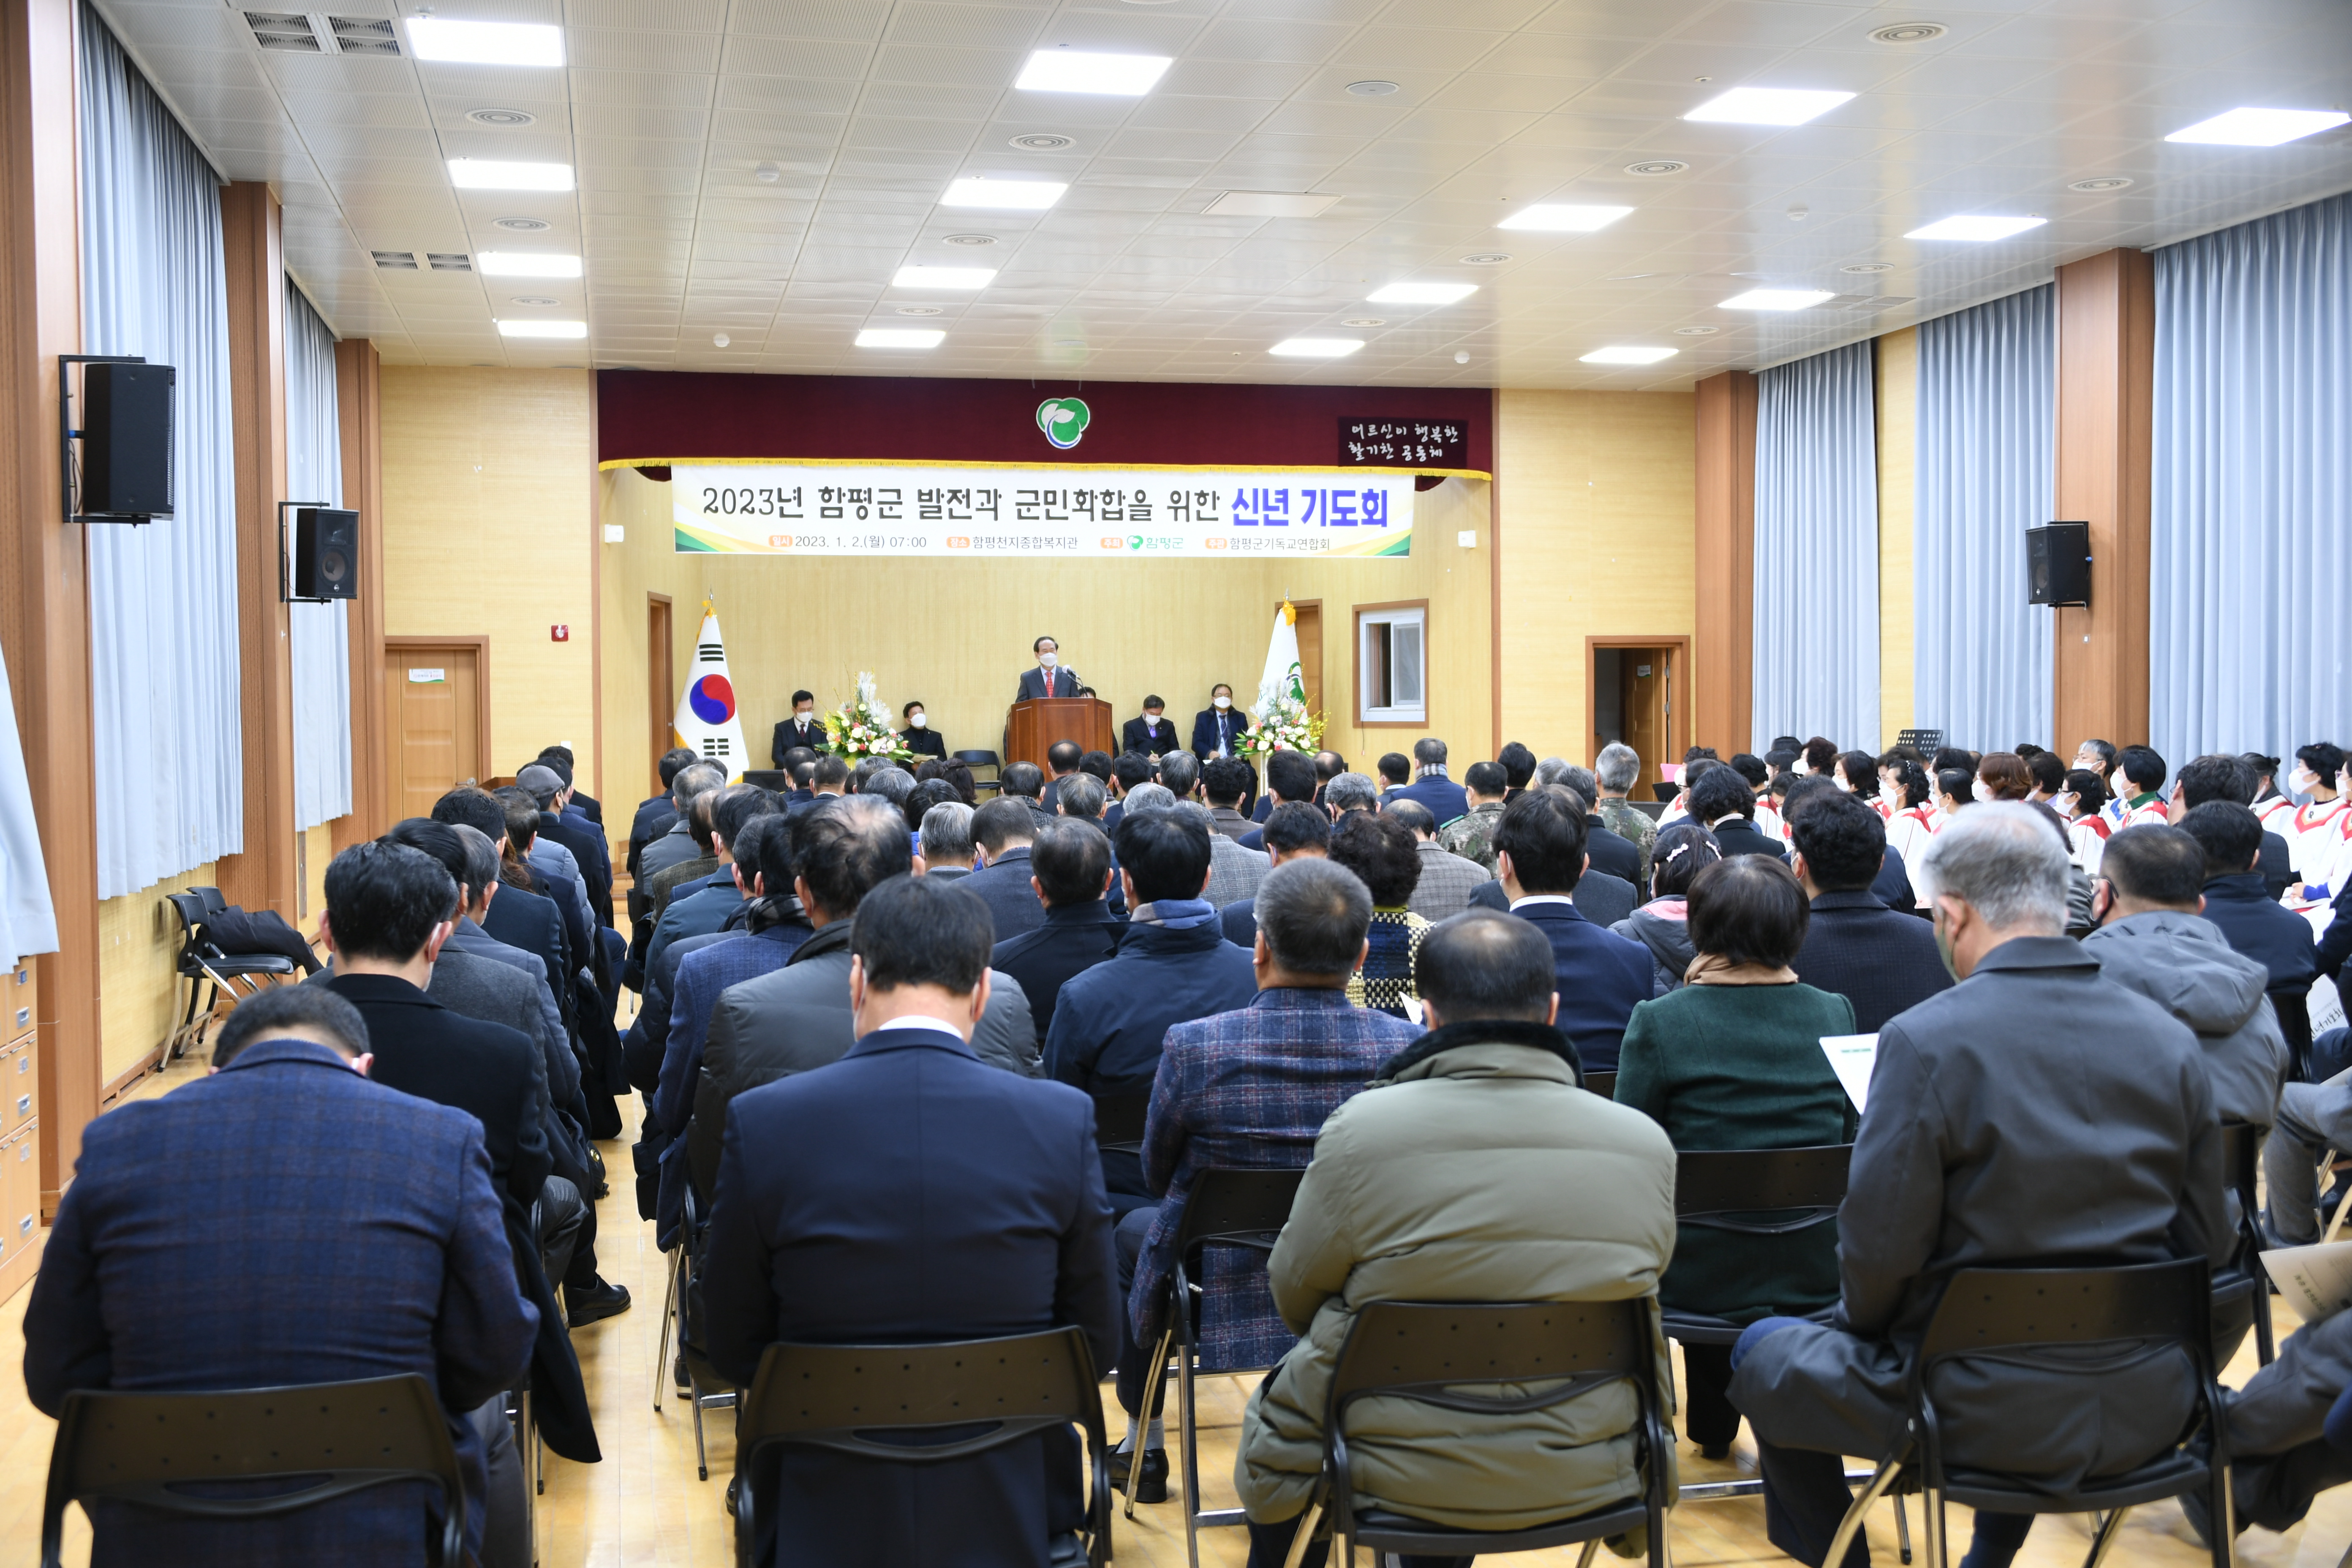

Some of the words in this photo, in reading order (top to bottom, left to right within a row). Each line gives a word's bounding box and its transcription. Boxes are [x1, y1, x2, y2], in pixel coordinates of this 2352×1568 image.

[1352, 423, 1407, 440] 어르신이
[1414, 424, 1458, 443] 행복한
[1348, 441, 1394, 461] 활기찬
[1401, 445, 1443, 462] 공동체
[703, 486, 804, 519] 2023년
[818, 486, 903, 521] 함평군
[917, 487, 1002, 521] 발전과
[1015, 488, 1153, 522] 군민화합을
[1167, 490, 1220, 523] 위한
[1231, 487, 1289, 527] 신년
[1301, 488, 1388, 528] 기도회
[772, 536, 789, 546] 일시
[795, 536, 829, 547] 2023.
[836, 536, 846, 547] 1.
[890, 536, 927, 547] 07:00
[950, 537, 967, 547] 장소
[972, 536, 1078, 549] 함평천지종합복지관
[1103, 538, 1120, 548] 주최
[1146, 537, 1183, 550] 함평군
[1230, 537, 1330, 550] 함평군기독교연합회
